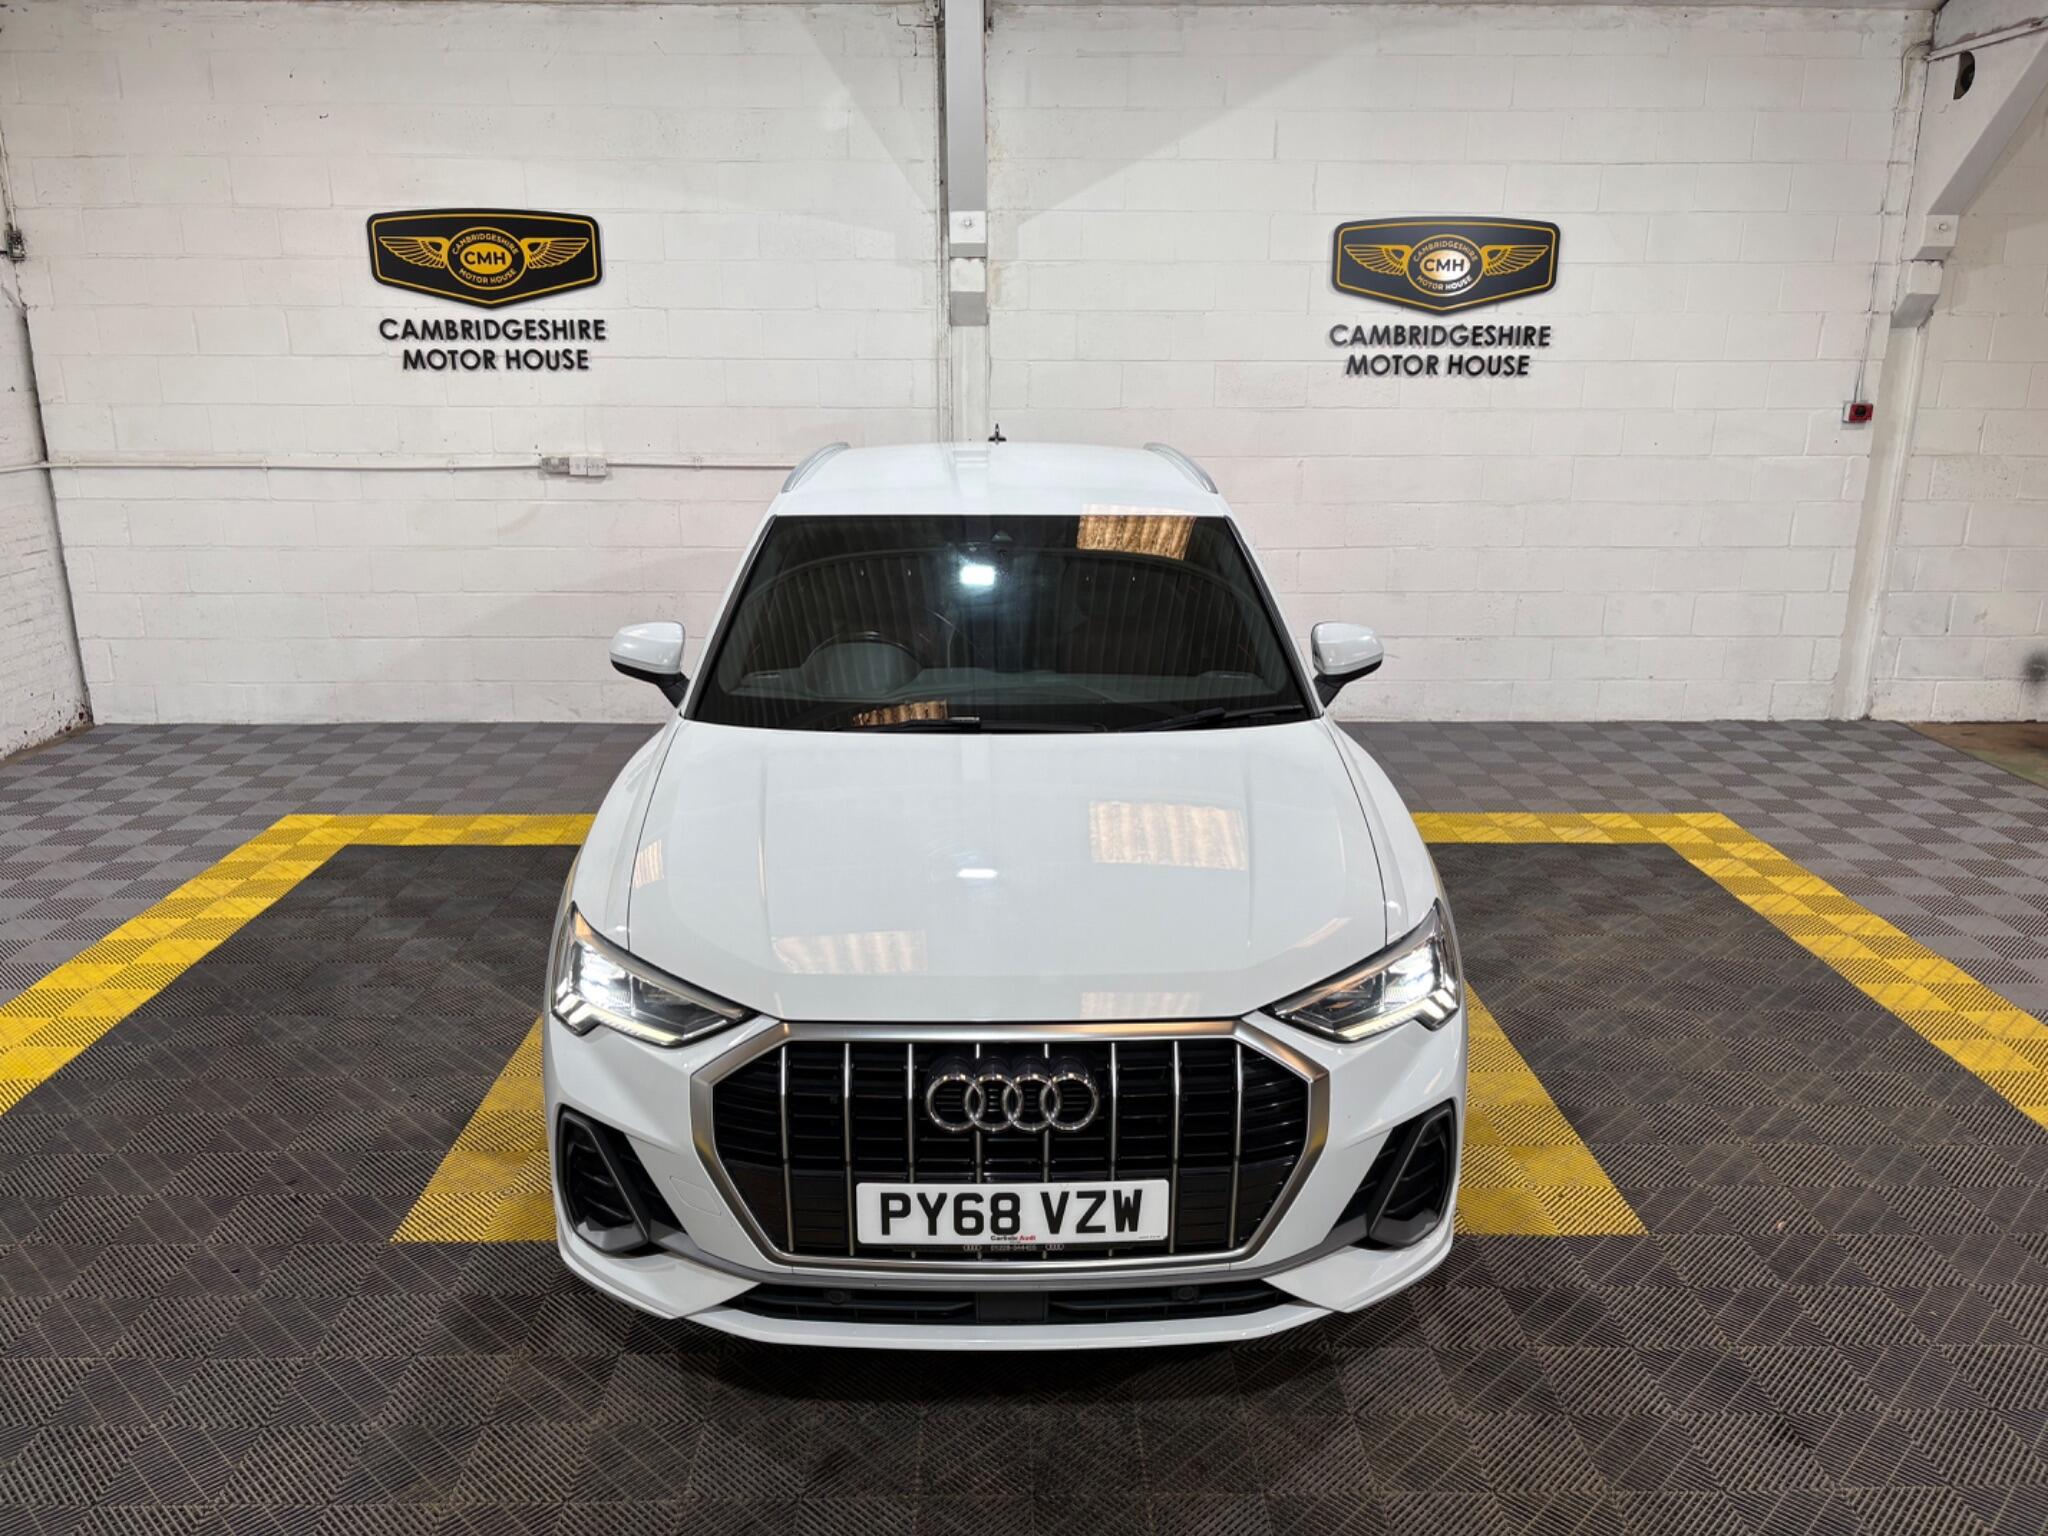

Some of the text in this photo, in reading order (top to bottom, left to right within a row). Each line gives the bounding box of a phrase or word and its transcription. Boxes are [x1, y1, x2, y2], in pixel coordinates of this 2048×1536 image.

[452, 233, 519, 255] CAMBRIDGESHIRE
[1412, 240, 1479, 262] CAMBRIDGESHIRE
[464, 251, 506, 265] CMH
[1423, 258, 1465, 272] CMH
[458, 267, 518, 285] MOTOR HOUSE
[1416, 275, 1473, 291] MOTOR HOUSE
[379, 318, 606, 341] CAMBRIDGESHIRE
[1329, 324, 1552, 347] CAMBRIDGESHIRE
[403, 349, 589, 371] MOTOR HOUSE
[1346, 355, 1530, 376] MOTOR HOUSE
[880, 1189, 1143, 1236] PY68 VZW
